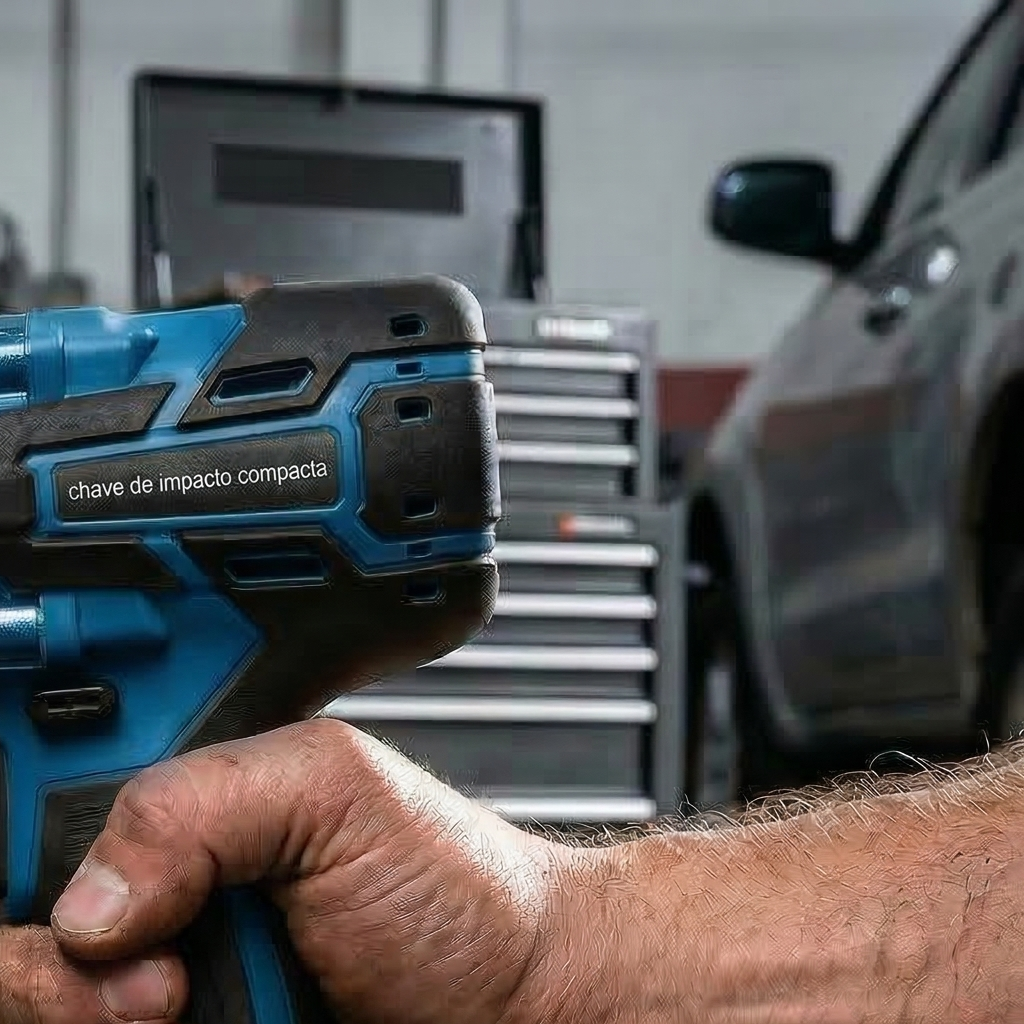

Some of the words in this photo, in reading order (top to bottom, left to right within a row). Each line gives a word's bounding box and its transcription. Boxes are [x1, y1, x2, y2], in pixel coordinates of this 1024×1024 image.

[68, 480, 124, 501] chave
[130, 475, 154, 495] de
[159, 468, 232, 495] impacto
[238, 459, 328, 488] compacta
